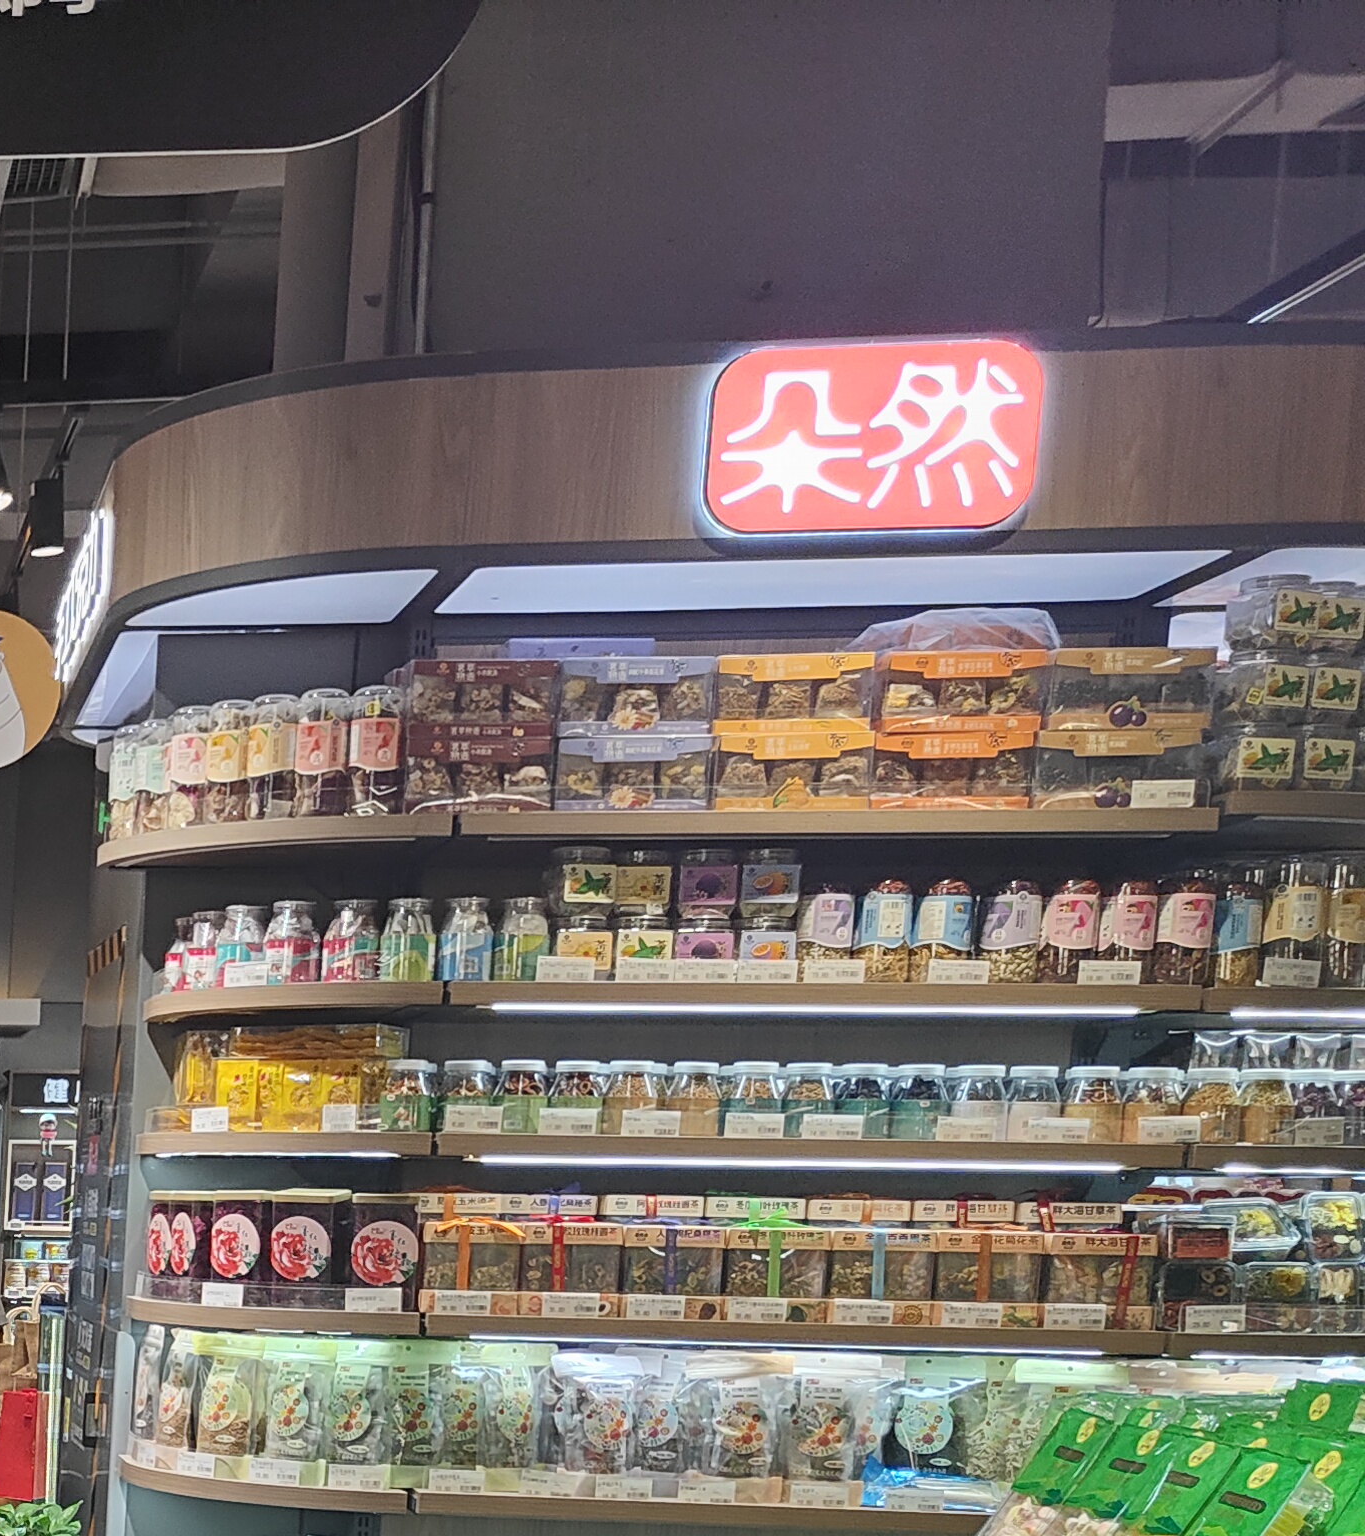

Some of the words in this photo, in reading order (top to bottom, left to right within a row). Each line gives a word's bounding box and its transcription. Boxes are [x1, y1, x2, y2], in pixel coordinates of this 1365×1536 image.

[721, 358, 1025, 512] 朵然
[971, 1234, 1039, 1245] 金花菊花茶
[1086, 1236, 1152, 1248] 胖大海甘茶
